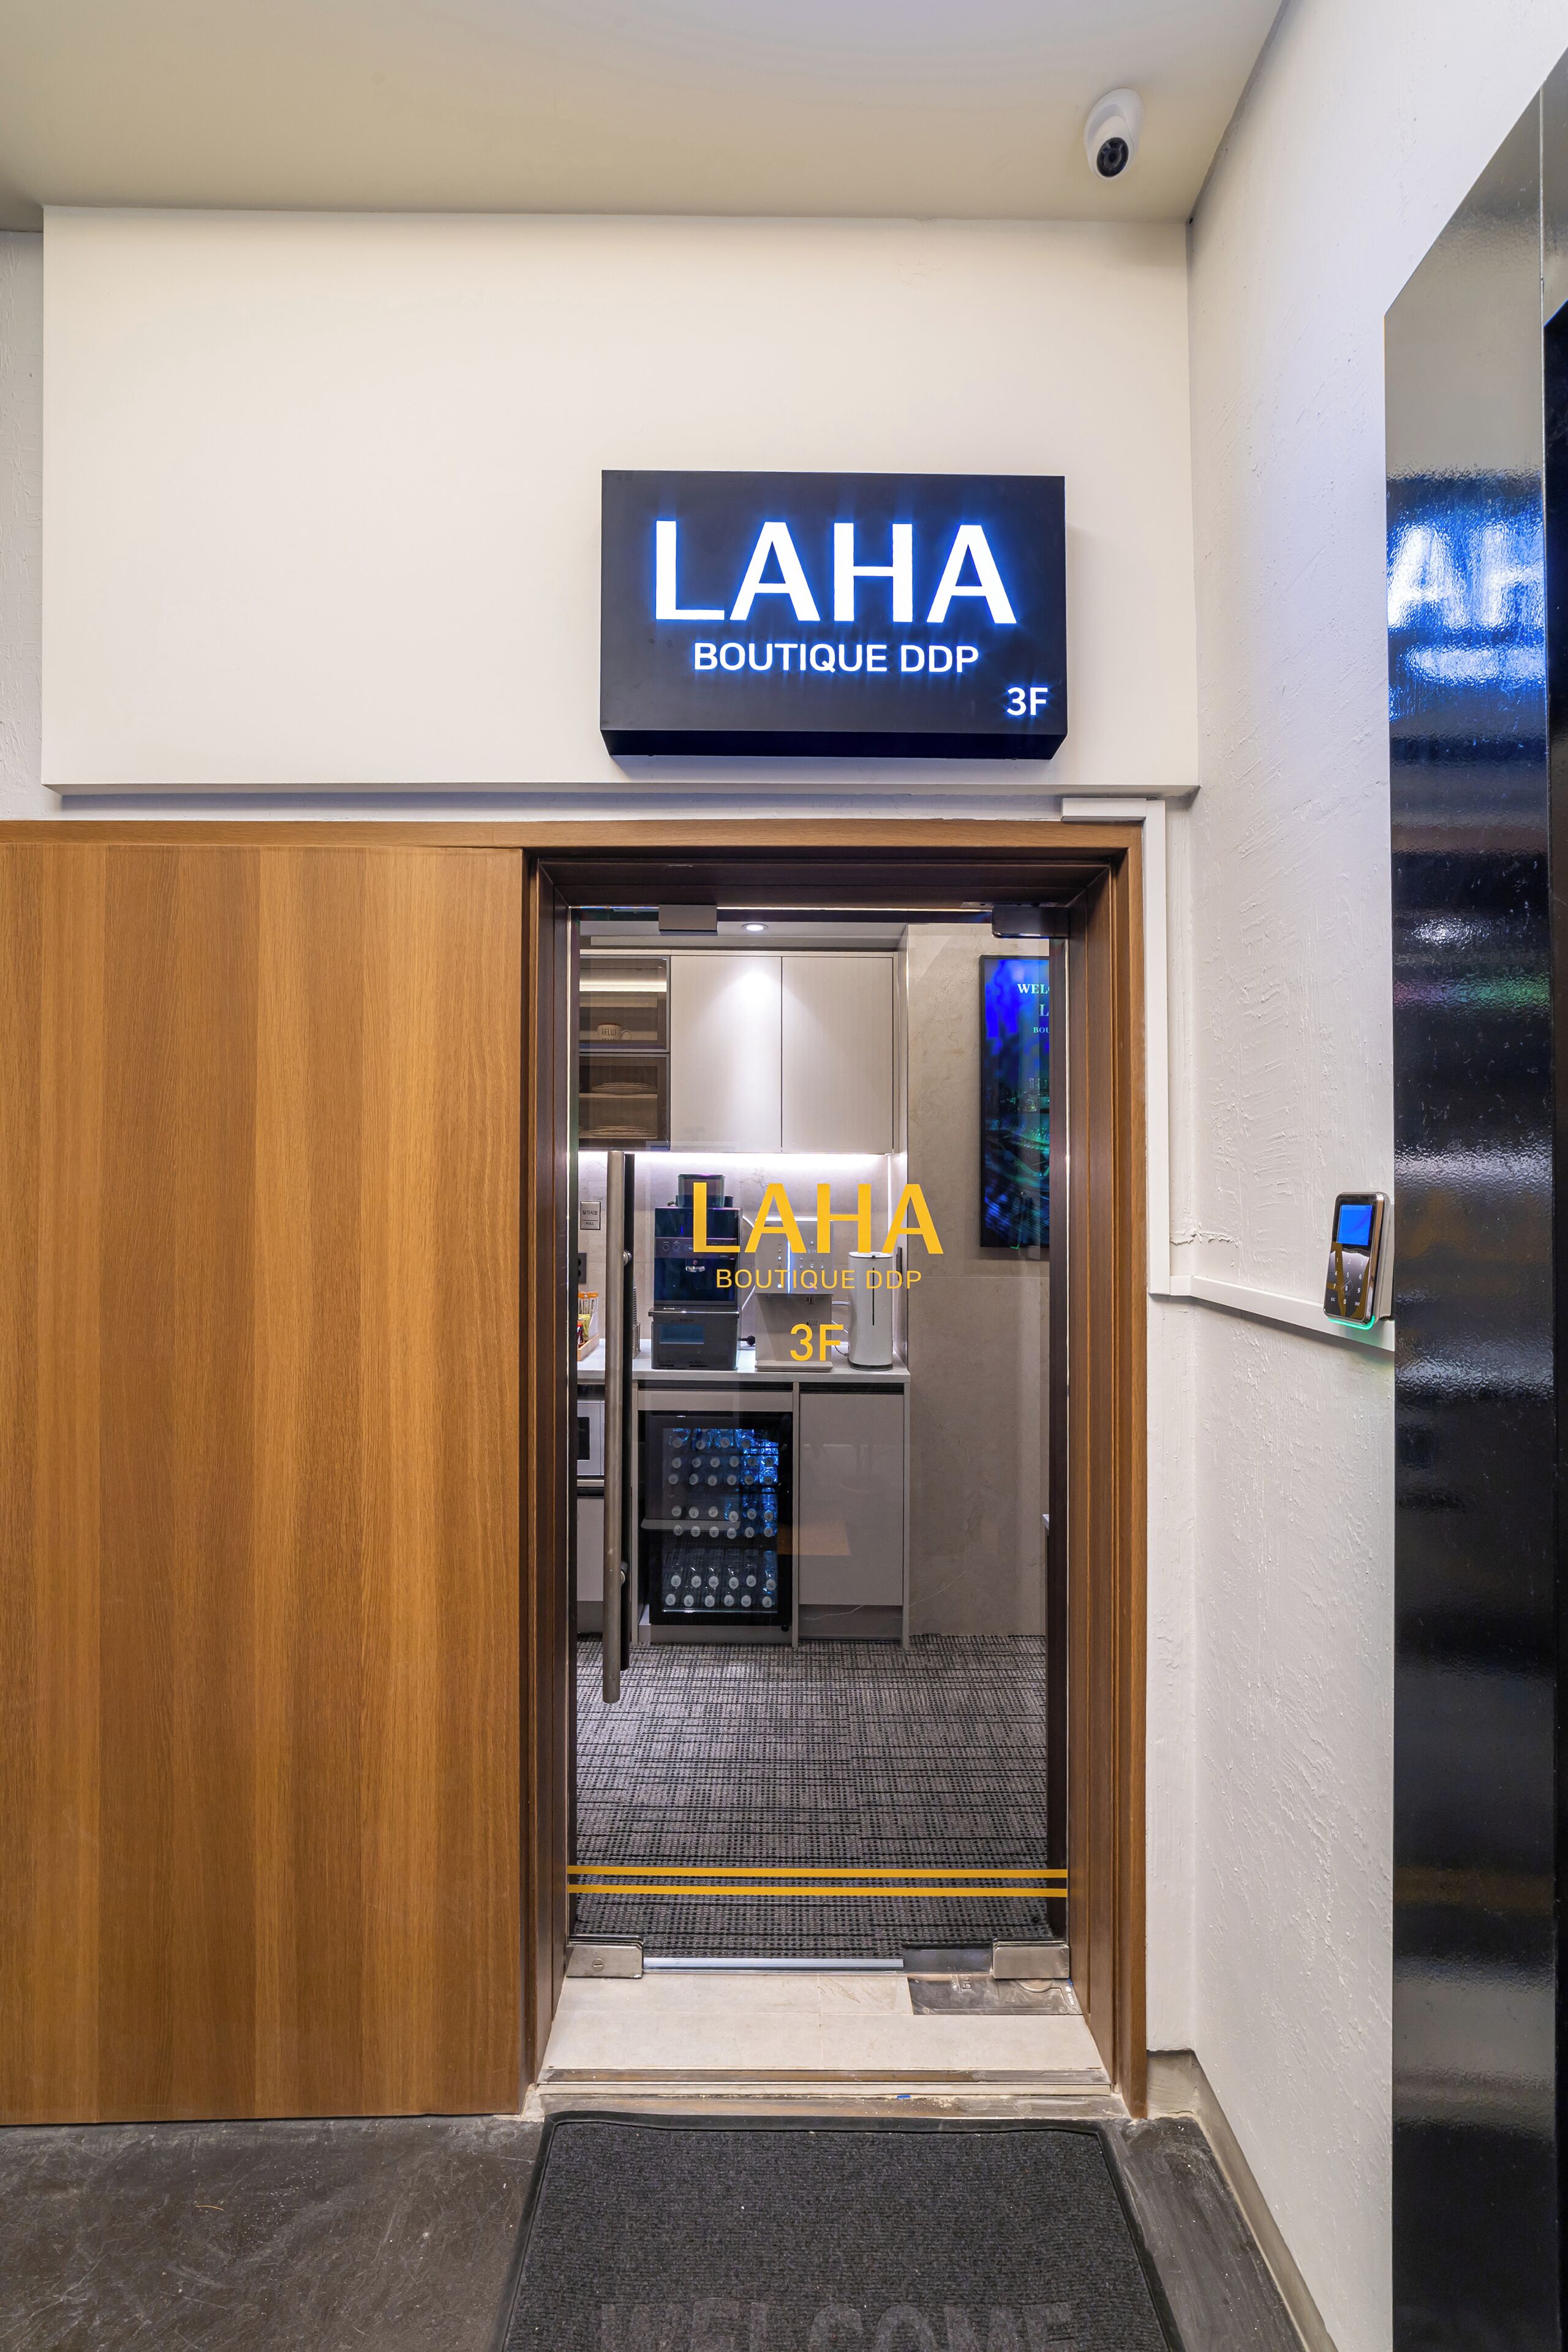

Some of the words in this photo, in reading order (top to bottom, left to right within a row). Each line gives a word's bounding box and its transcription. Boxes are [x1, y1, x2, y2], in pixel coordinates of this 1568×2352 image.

[655, 520, 1017, 624] LAHA
[694, 642, 887, 673] BOUTIQUE
[900, 644, 979, 673] DDP
[1006, 687, 1048, 716] 3F
[1017, 984, 1050, 994] WEL
[601, 1027, 616, 1036] HELLO
[693, 1182, 944, 1254] LAHA
[717, 1268, 855, 1289] BOUTIQUE
[866, 1270, 922, 1289] DDP
[790, 1323, 844, 1362] 3F
